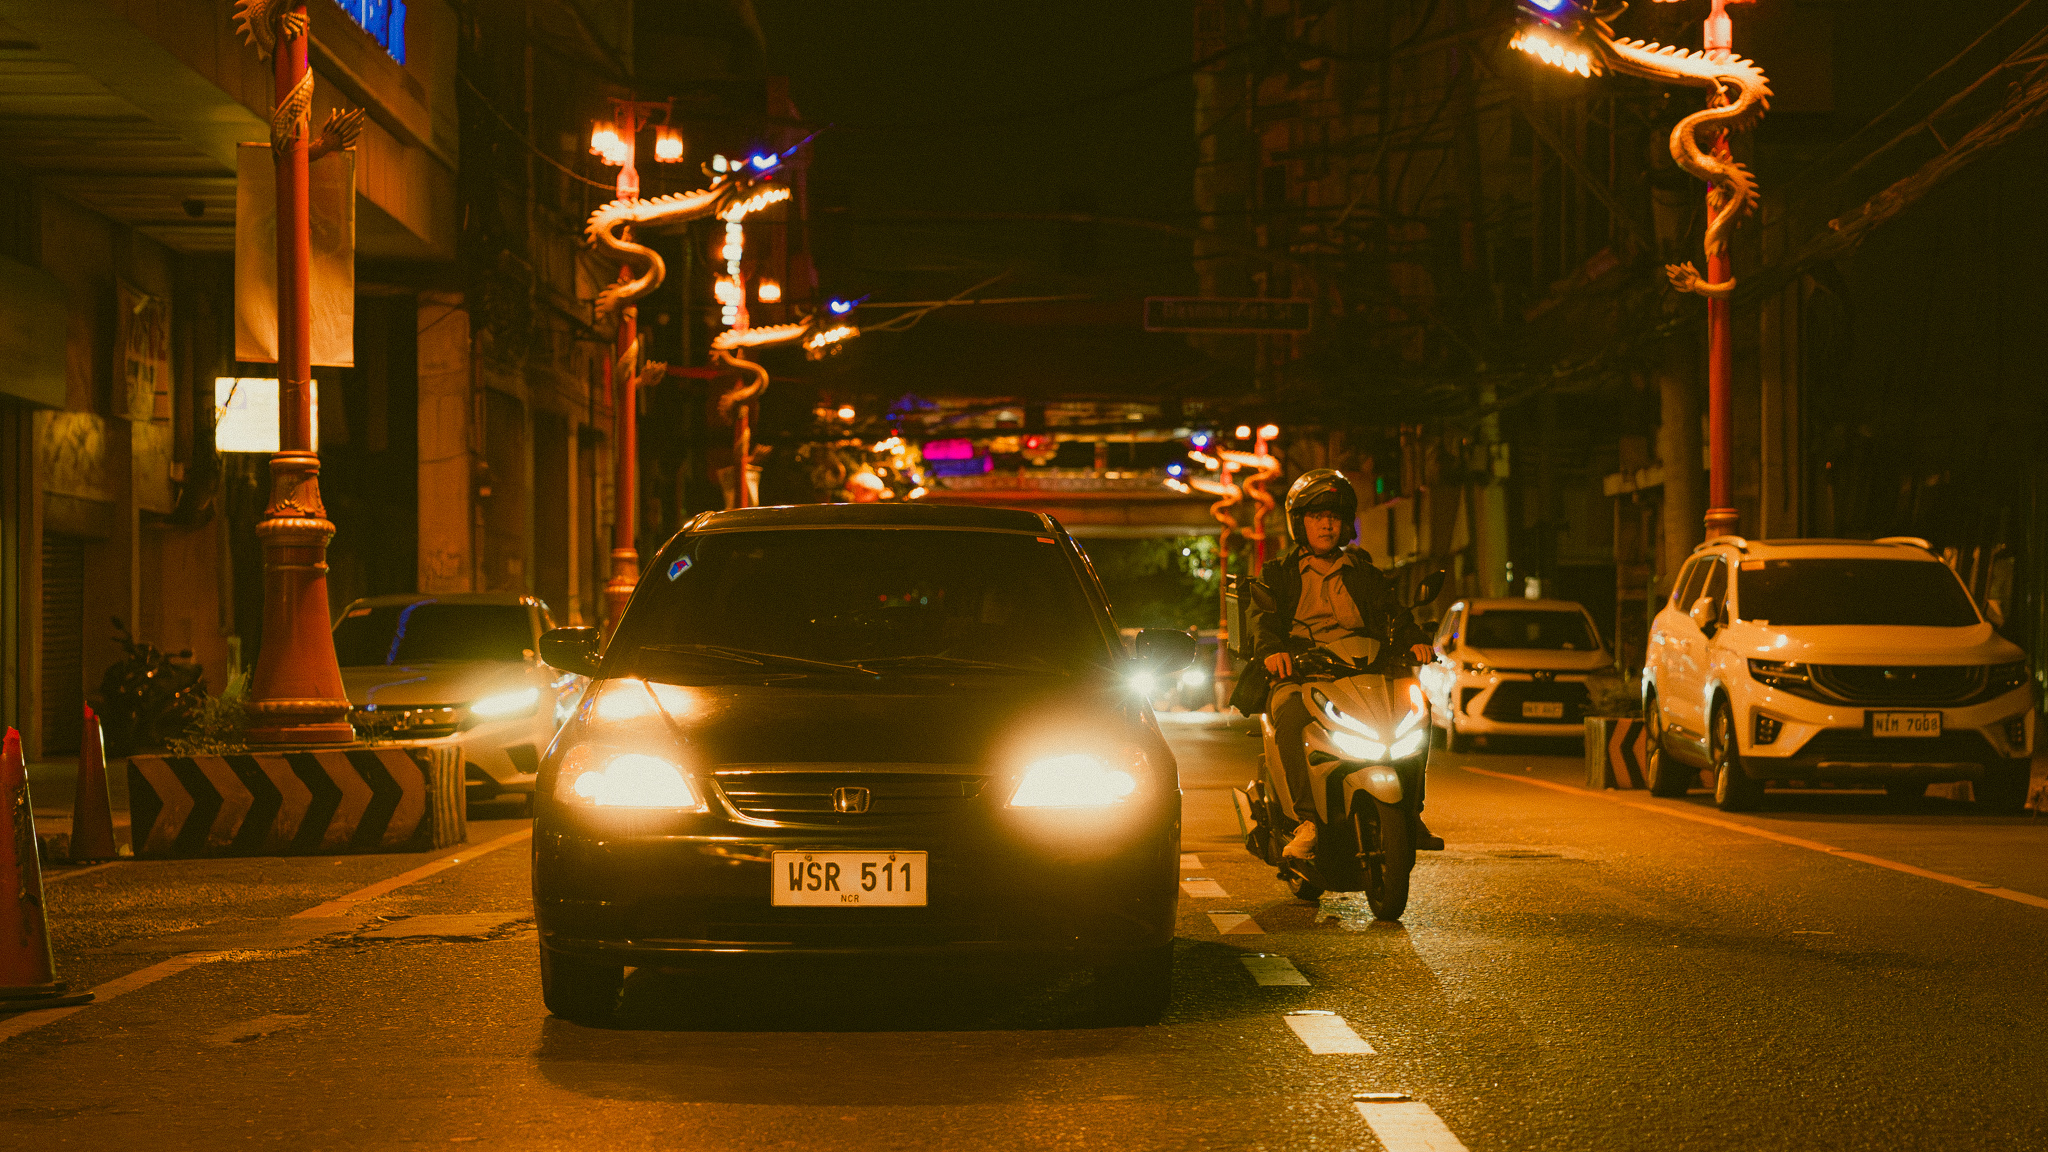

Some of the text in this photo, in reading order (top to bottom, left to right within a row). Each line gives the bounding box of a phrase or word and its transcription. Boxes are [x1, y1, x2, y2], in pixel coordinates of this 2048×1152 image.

[1875, 718, 1899, 731] NIM
[788, 861, 911, 892] WSR 511
[840, 894, 860, 903] NCR
